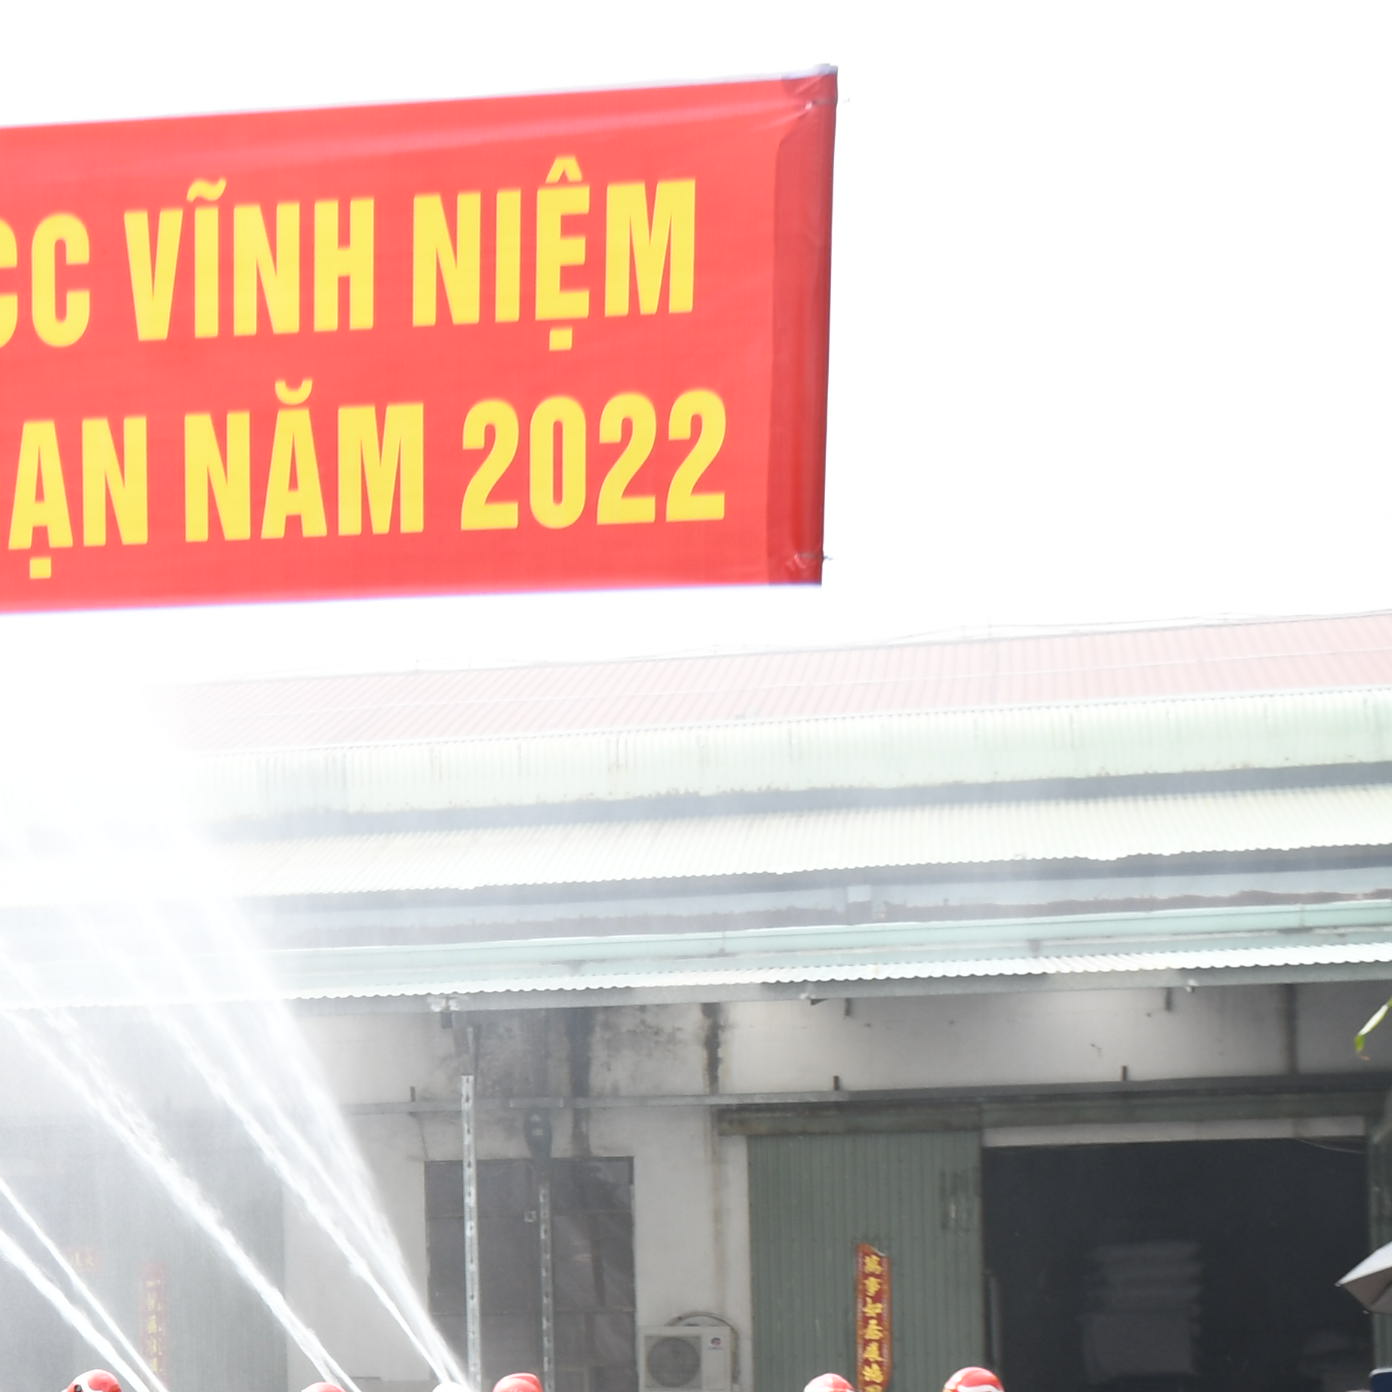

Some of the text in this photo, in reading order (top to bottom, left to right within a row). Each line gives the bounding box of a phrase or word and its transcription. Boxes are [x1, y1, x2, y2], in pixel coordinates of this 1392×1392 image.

[125, 181, 373, 339] VĨNH
[414, 159, 694, 349] NIỆM
[186, 381, 423, 540] NĂM
[462, 392, 725, 528] 2022
